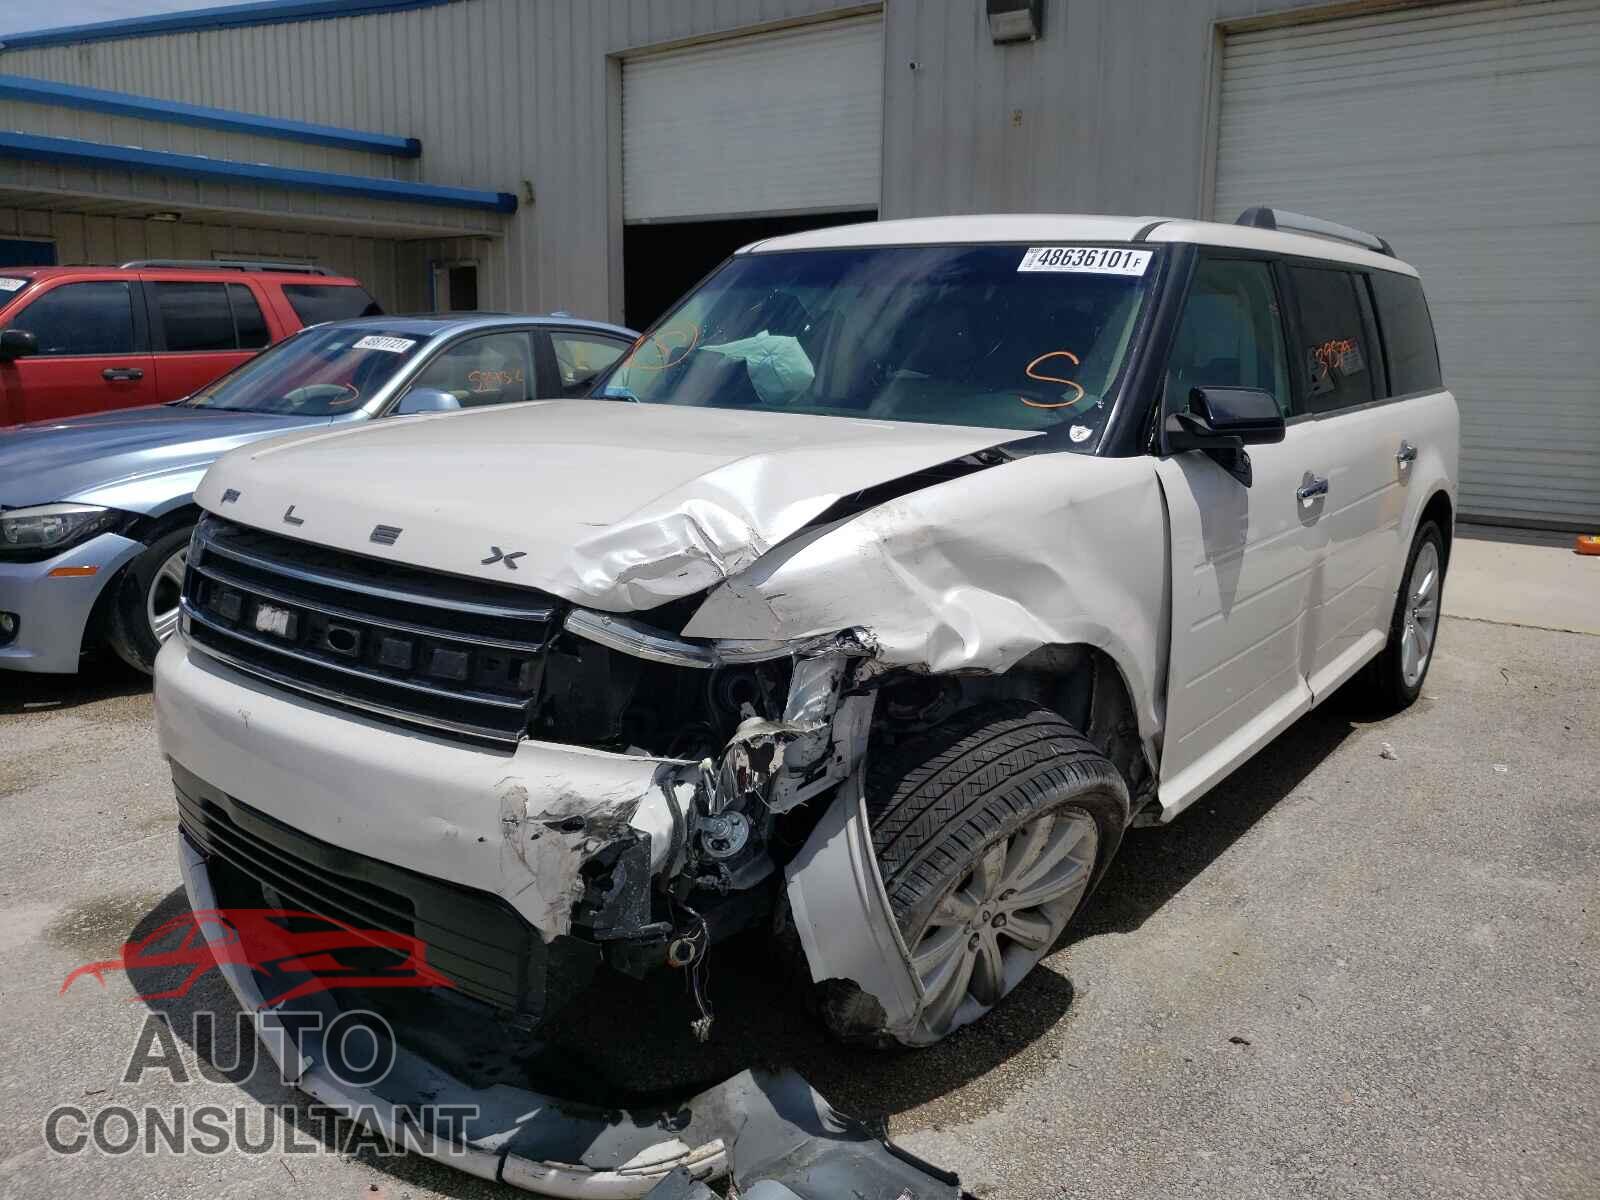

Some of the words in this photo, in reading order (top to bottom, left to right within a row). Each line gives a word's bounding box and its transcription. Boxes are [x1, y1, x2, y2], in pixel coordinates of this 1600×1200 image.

[1038, 249, 1132, 269] 48636101
[1132, 257, 1142, 268] F
[1020, 351, 1085, 408] S
[220, 487, 528, 571] FLEX
